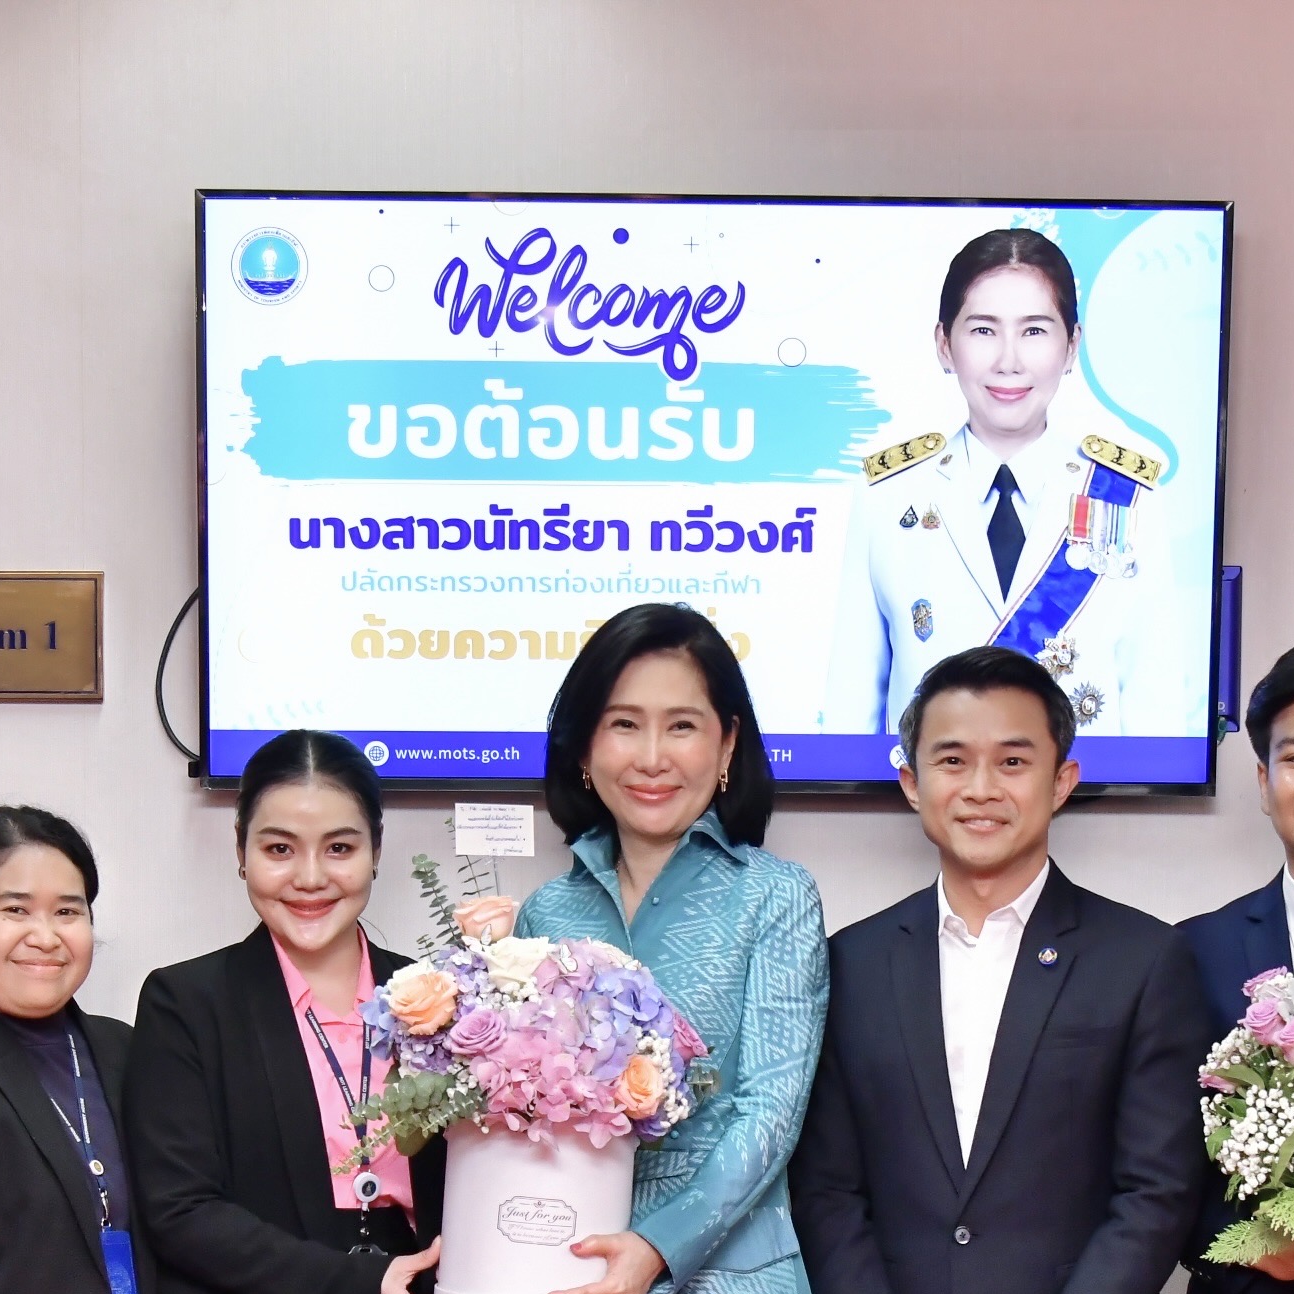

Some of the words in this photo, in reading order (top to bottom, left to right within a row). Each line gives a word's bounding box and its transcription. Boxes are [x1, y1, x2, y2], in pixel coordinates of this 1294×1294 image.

[434, 228, 745, 381] Welcome
[347, 378, 755, 462] ขอต้อนรับ
[288, 503, 630, 552] นางสาวนัทรียา
[650, 505, 817, 554] ทวีวงศ์
[341, 563, 762, 595] ปลัดกระทรวงการท่องเที่ยวและกีฬา
[44, 621, 57, 650] 1
[395, 747, 520, 764] www.mots.go.th
[768, 749, 792, 762] .TH
[308, 1013, 321, 1033] LEARNING
[318, 1031, 328, 1049] CENTER
[343, 1084, 354, 1107] LEARNING
[502, 1207, 529, 1221] Just
[528, 1209, 550, 1221] for
[548, 1215, 571, 1223] you
